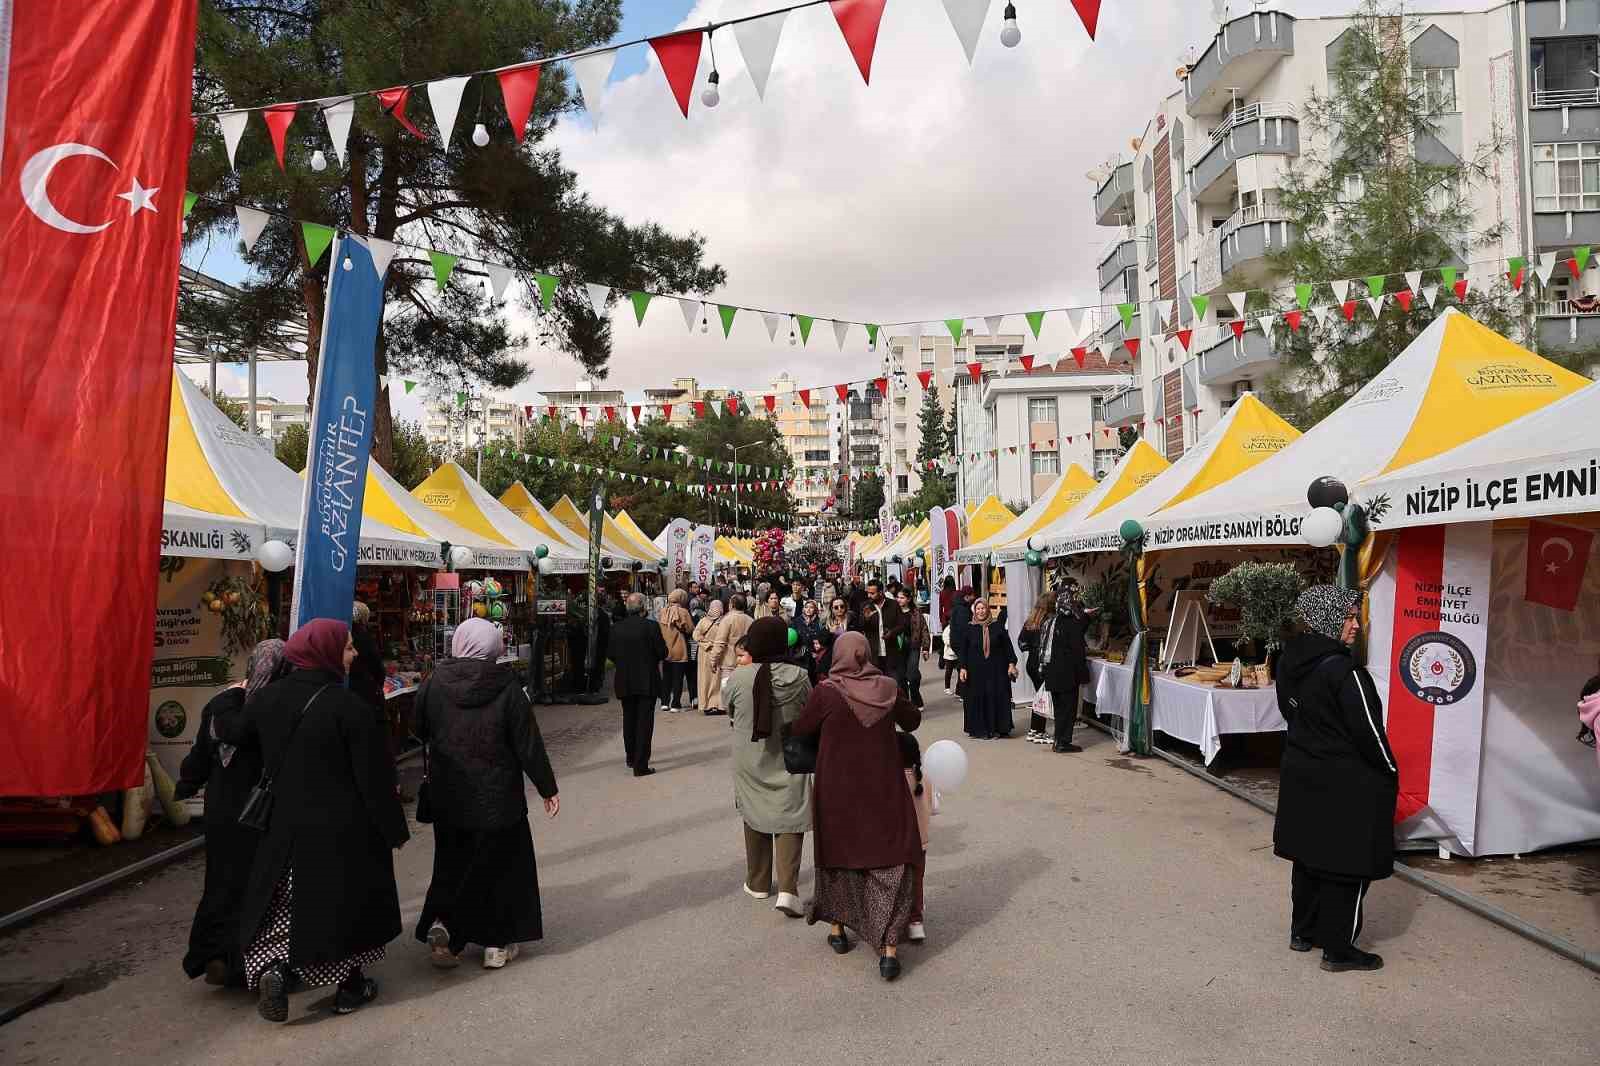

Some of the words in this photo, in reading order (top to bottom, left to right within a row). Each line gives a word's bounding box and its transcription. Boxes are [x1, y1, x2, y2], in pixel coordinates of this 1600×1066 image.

[1406, 482, 1460, 516] NİZİP
[1466, 478, 1518, 511] İLÇE
[1526, 459, 1600, 502] EMNİ
[1154, 525, 1175, 544] NİZİP
[1176, 521, 1221, 542] ORGANİZE
[1223, 516, 1263, 539] SANAYİ
[1266, 514, 1303, 537] BÖLG
[160, 528, 224, 550] ŞKANLIĞI
[1100, 534, 1121, 548] BÖLGES
[376, 544, 409, 562] ETKİNLİK
[1447, 583, 1473, 598] İLÇE
[1416, 596, 1469, 610] EMNİYET
[156, 616, 201, 629] rliği'nde
[1403, 607, 1480, 625] MÜDÜRLÜĞÜ
